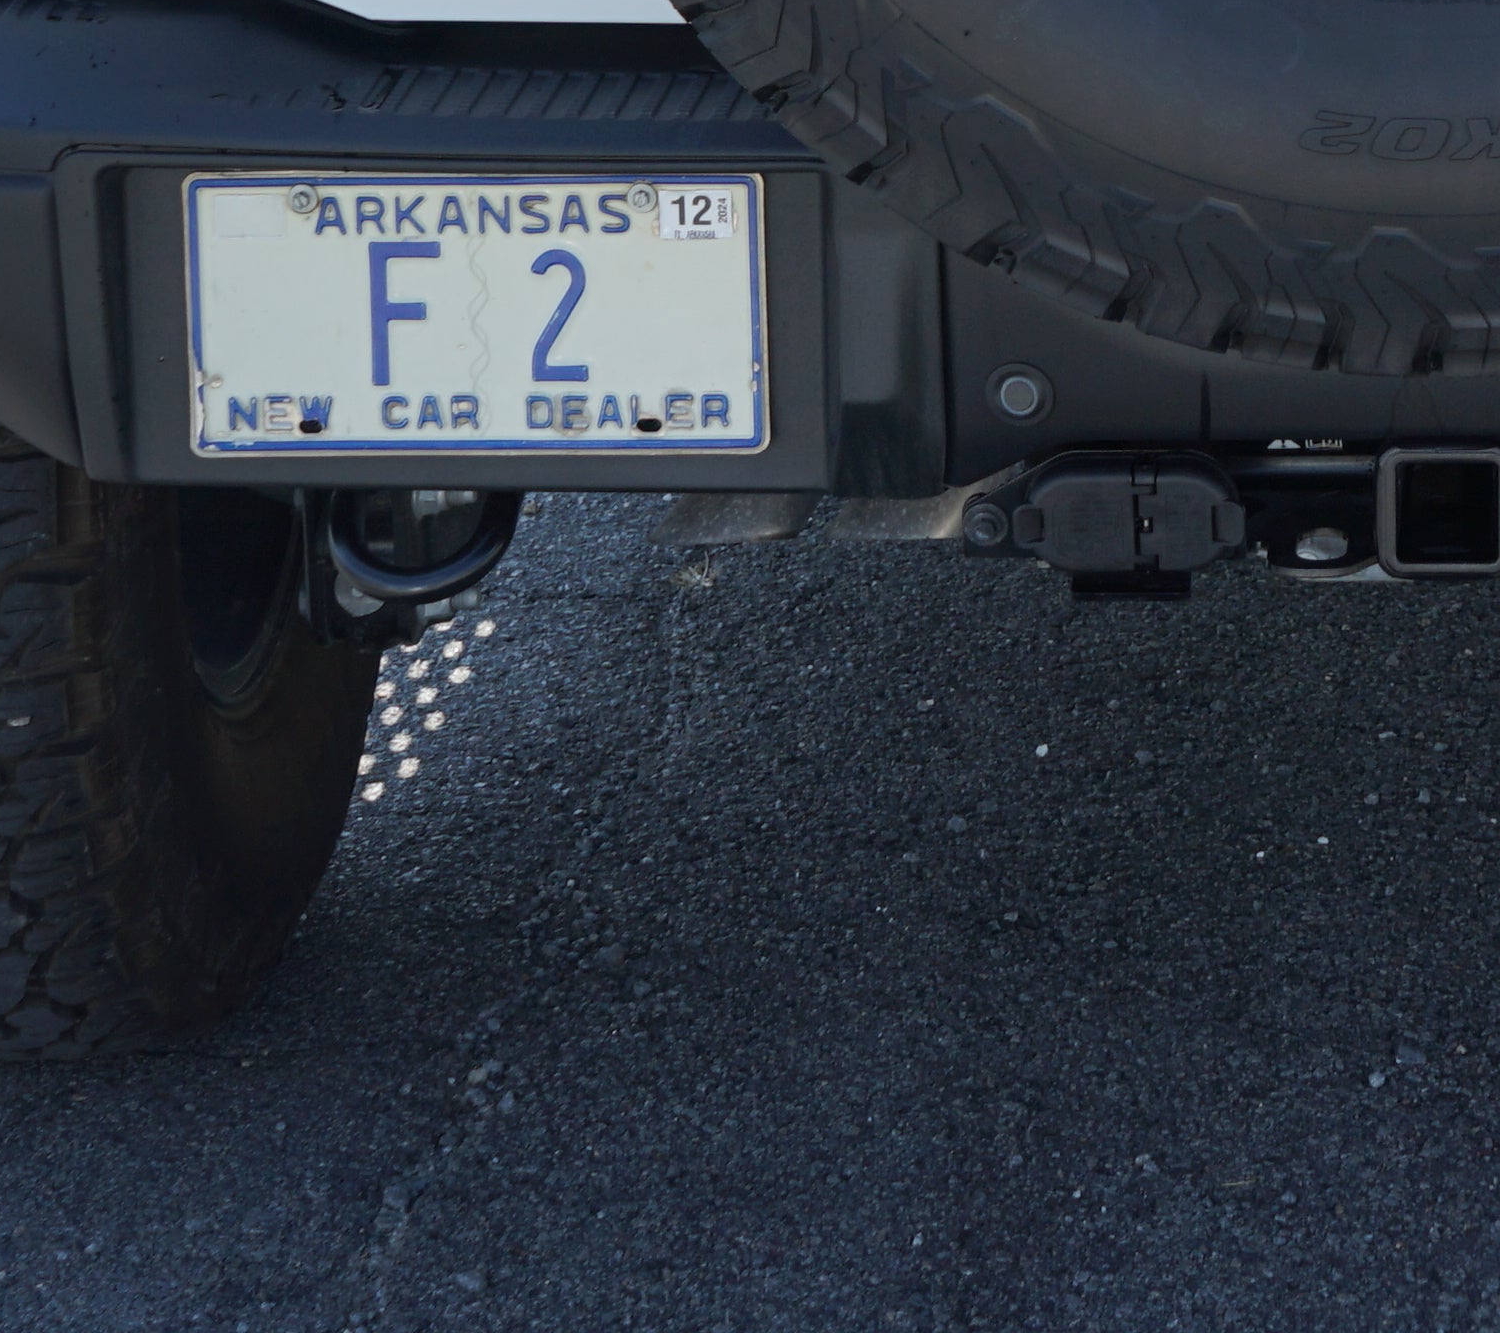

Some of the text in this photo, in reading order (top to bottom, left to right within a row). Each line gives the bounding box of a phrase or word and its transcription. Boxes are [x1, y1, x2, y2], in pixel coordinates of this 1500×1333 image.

[314, 194, 632, 236] ARKANSAS
[671, 195, 712, 226] 12
[717, 197, 728, 224] 2024
[368, 241, 590, 386] F 2
[227, 393, 731, 432] NEW CAR DEALER
